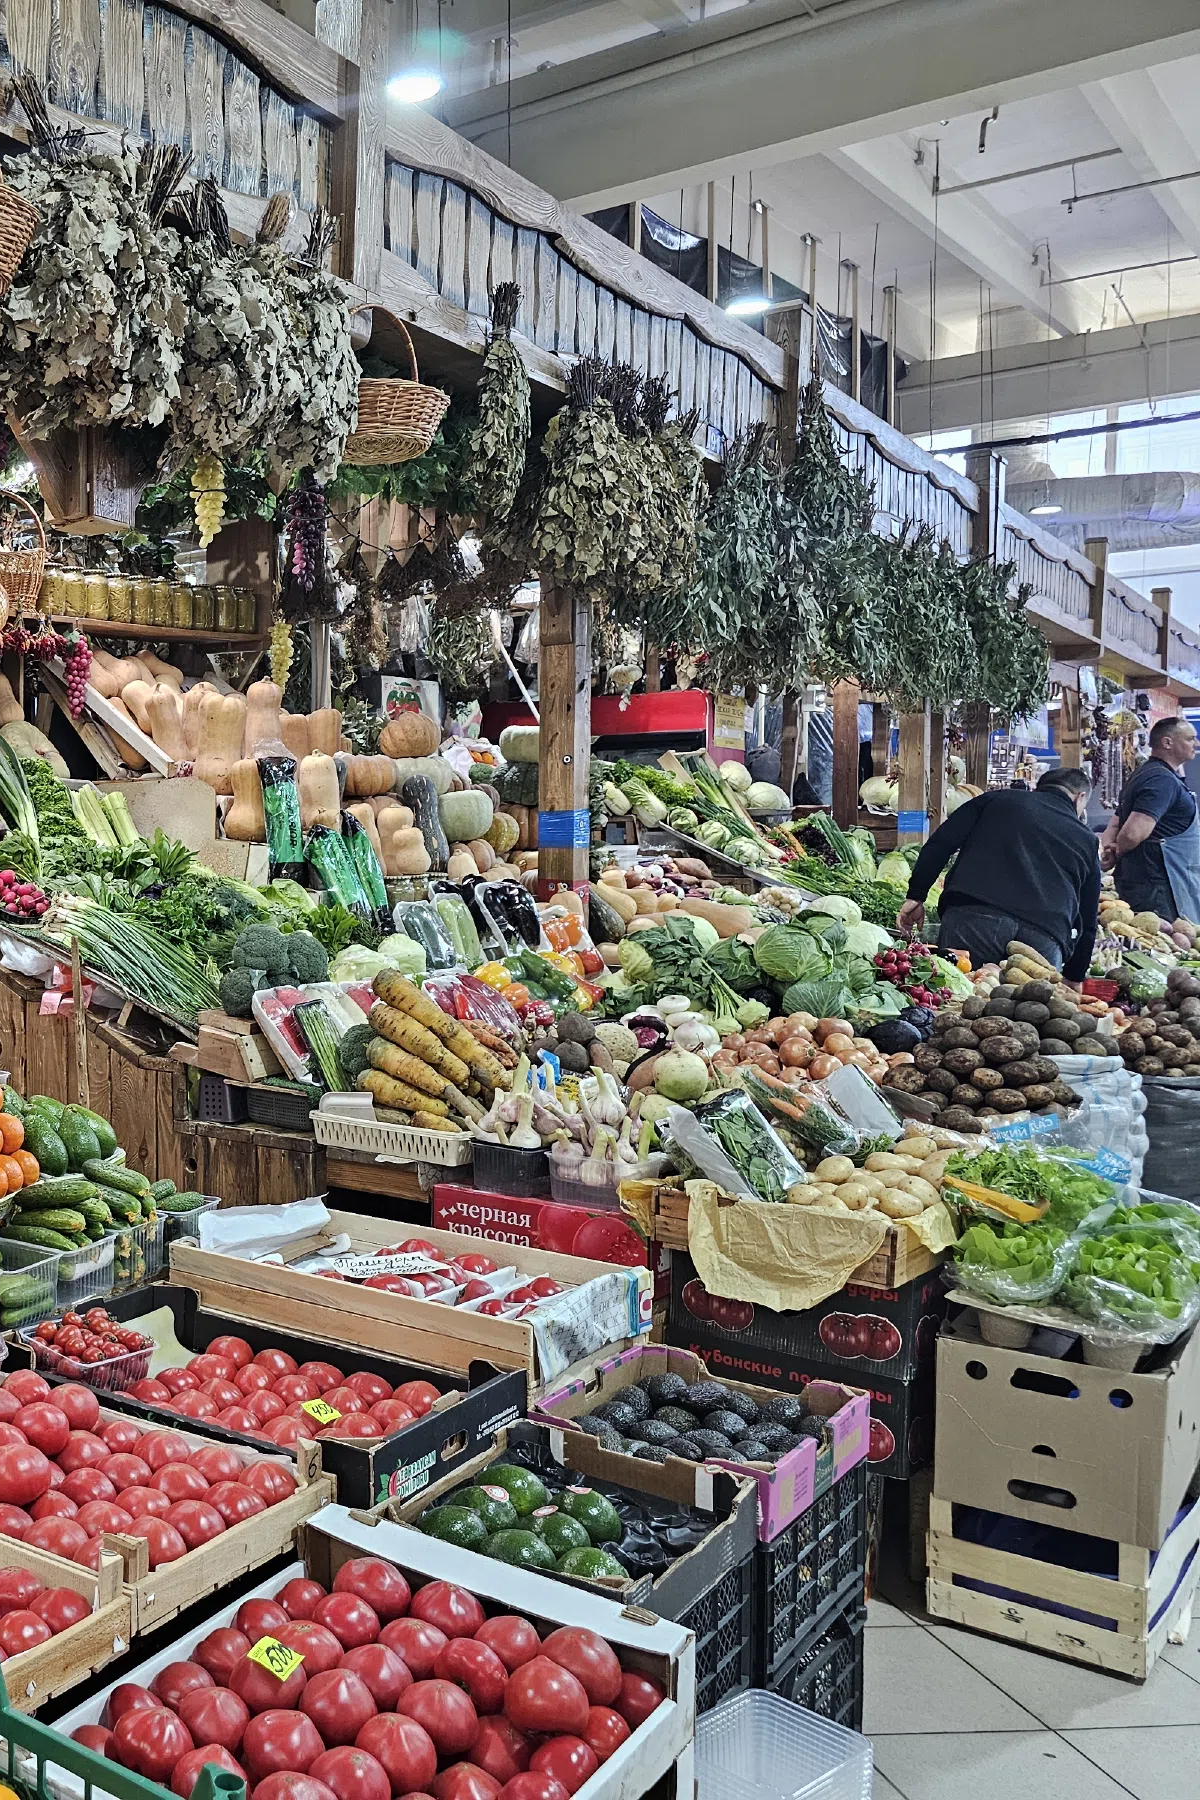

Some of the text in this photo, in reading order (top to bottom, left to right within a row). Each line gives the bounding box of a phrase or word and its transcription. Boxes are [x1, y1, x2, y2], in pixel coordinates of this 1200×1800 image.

[456, 1202, 531, 1228] черная
[448, 1221, 530, 1247] красота
[690, 1343, 782, 1378] Кубанские
